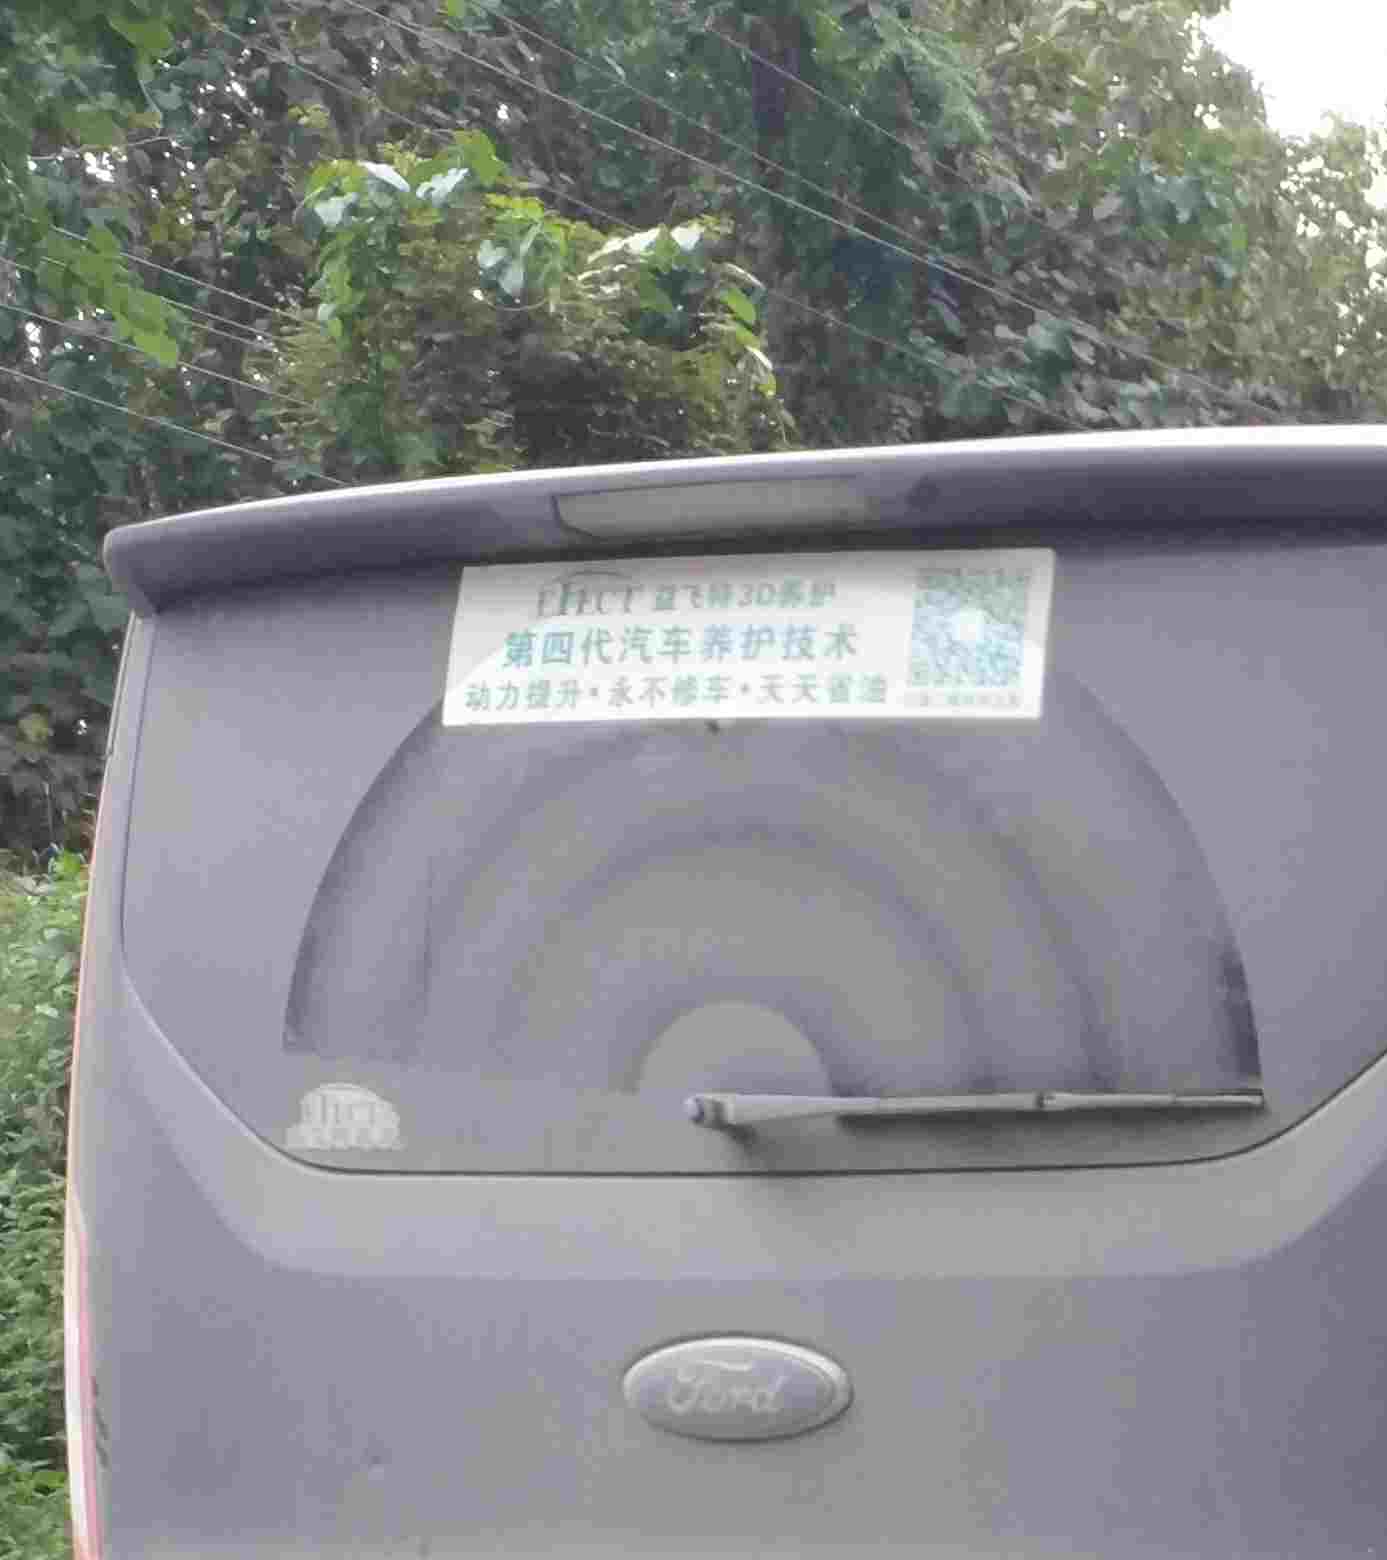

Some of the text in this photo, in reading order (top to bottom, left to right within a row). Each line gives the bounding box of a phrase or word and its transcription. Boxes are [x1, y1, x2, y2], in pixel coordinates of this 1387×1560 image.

[502, 623, 859, 669] 第四代汽车养护技术
